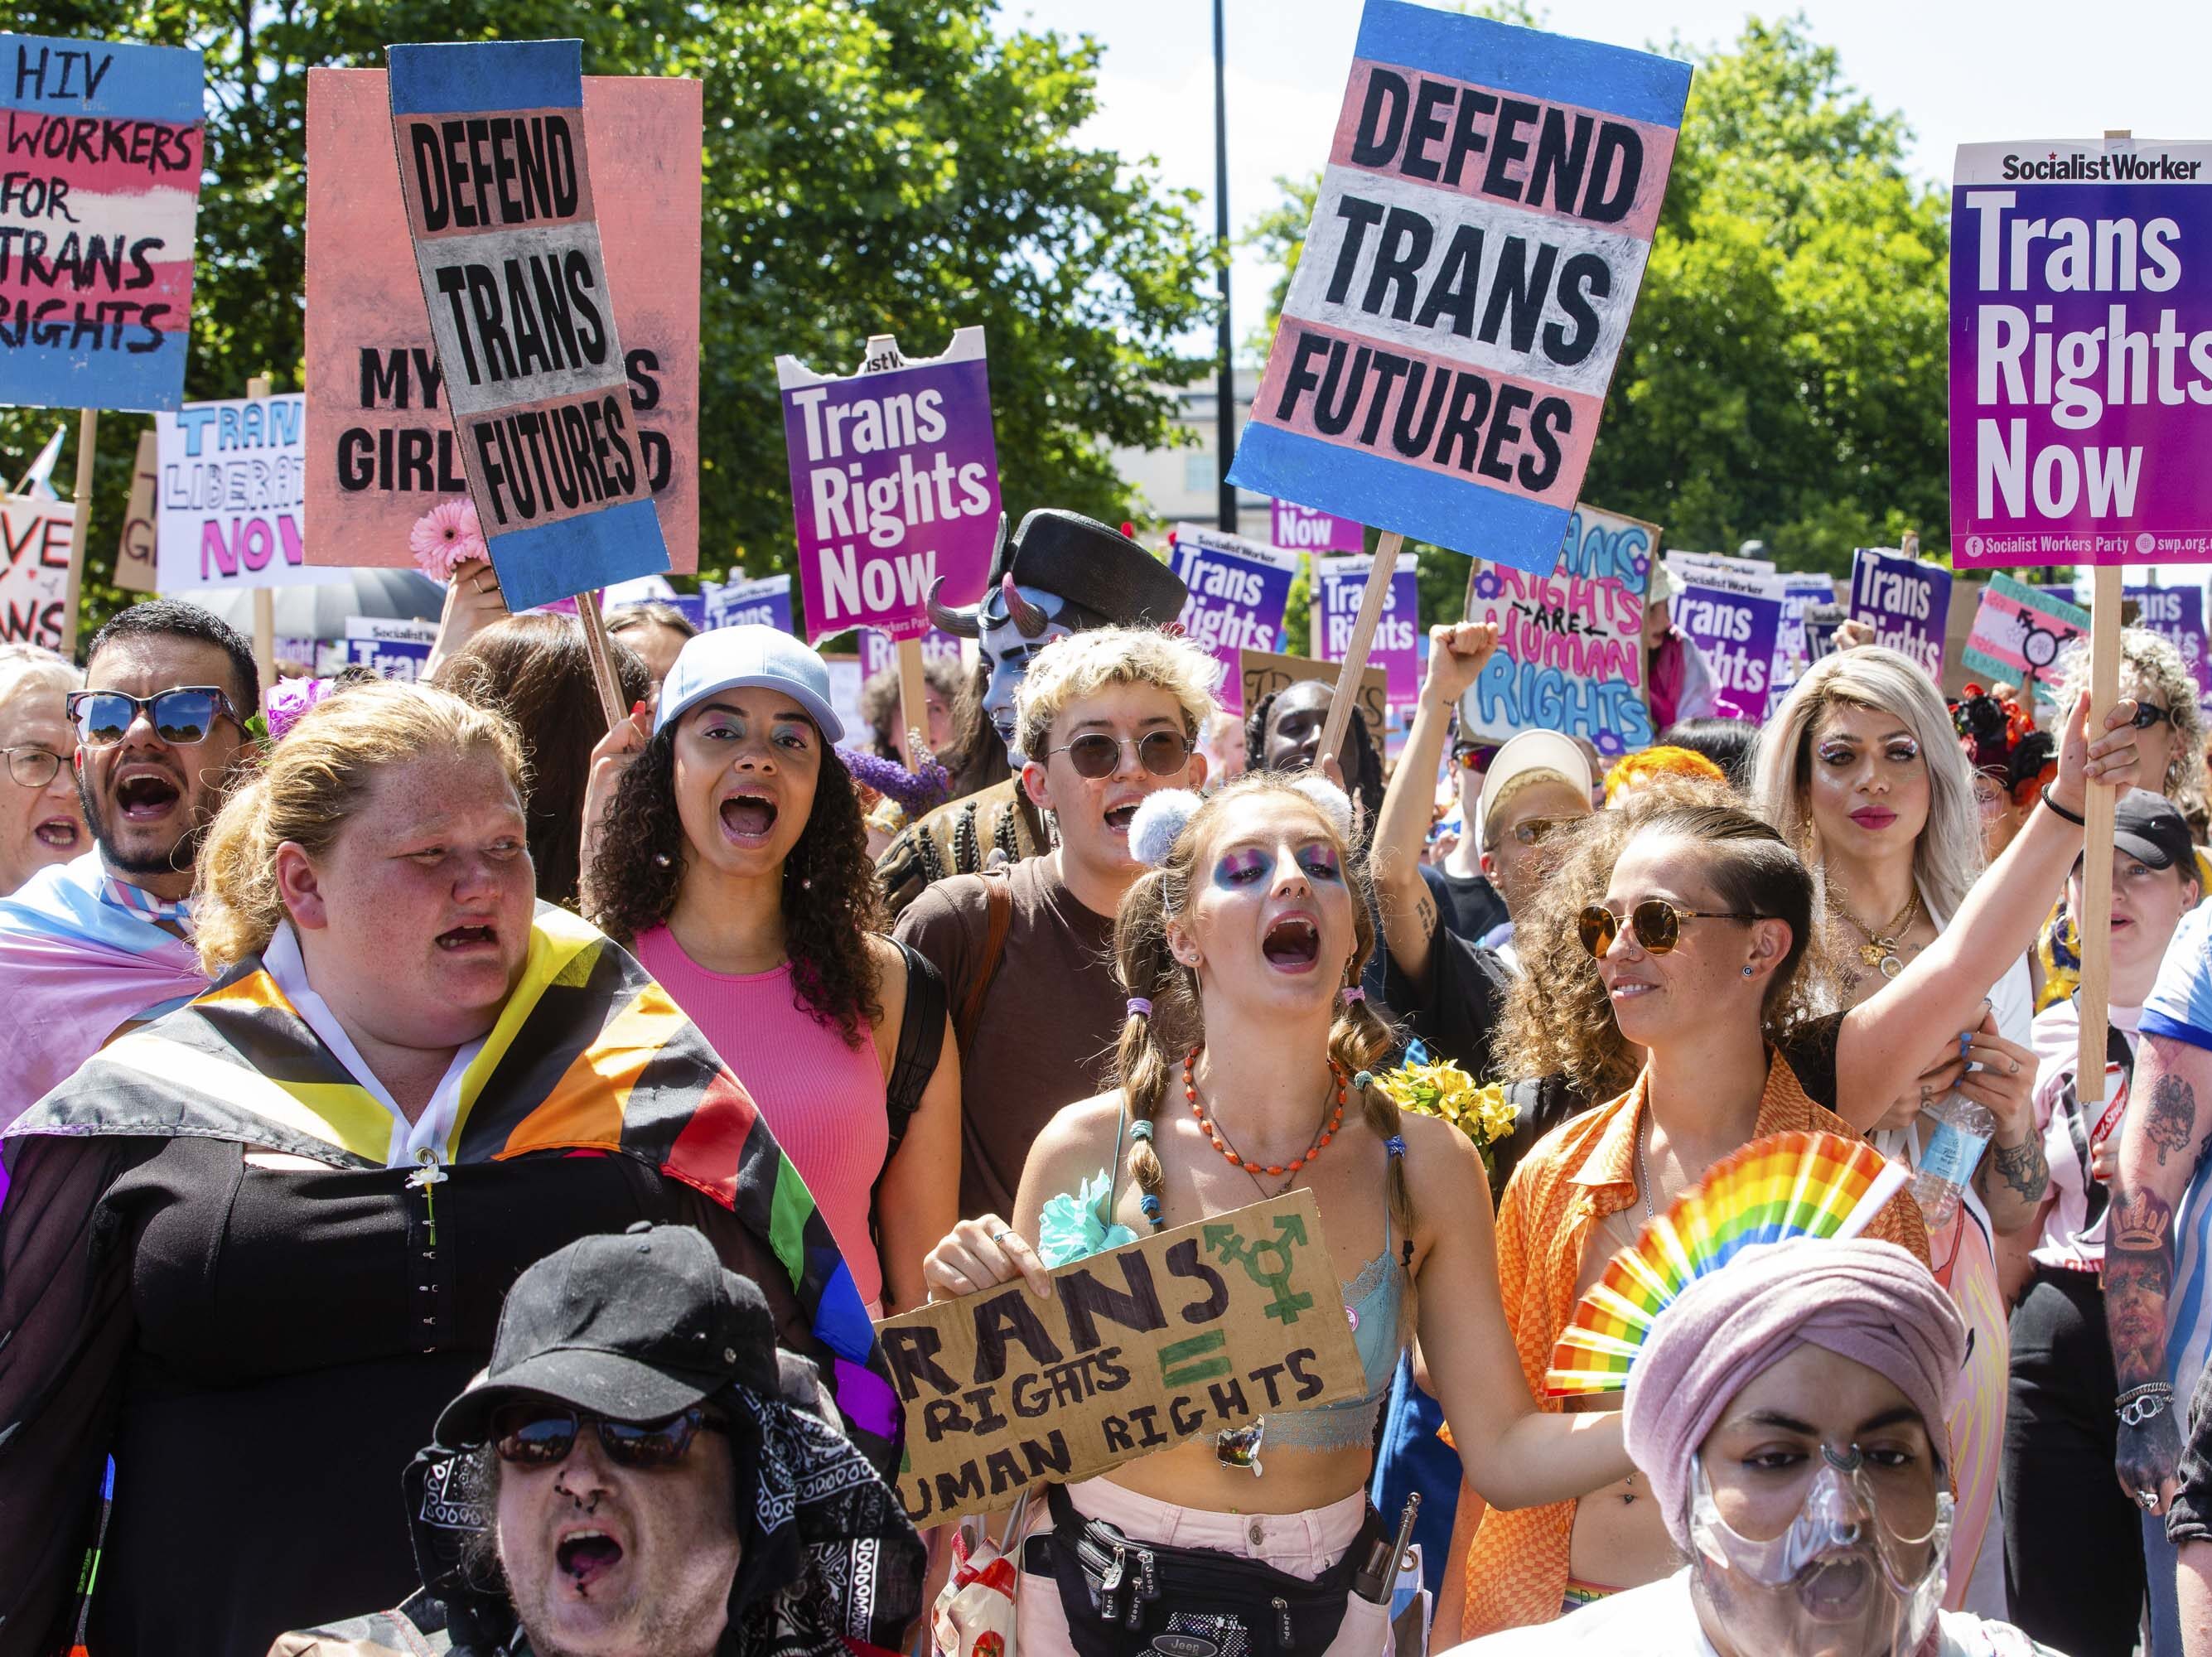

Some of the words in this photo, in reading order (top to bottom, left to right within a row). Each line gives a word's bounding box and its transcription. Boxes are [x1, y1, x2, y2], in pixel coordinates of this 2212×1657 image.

[16, 44, 113, 99] HIV
[7, 112, 195, 175] WORKERS
[410, 115, 578, 232] DEFEND
[1351, 67, 1645, 223] DEFEND
[2002, 152, 2110, 180] Socialist
[2113, 153, 2201, 180] Worker
[1, 171, 80, 222] FOR
[0, 226, 166, 292] TRANS
[1966, 191, 2181, 292] Trans
[436, 249, 606, 385] TRANS
[1326, 195, 1611, 366] TRANS
[360, 347, 441, 408] MY
[1276, 333, 1573, 493] FUTURES
[176, 401, 302, 457] TRAN
[474, 395, 637, 525] FUTURES
[792, 387, 947, 461] Trans
[166, 456, 304, 511] LIBERAT
[810, 452, 991, 548] Rights
[1978, 418, 2144, 519] Now
[201, 514, 302, 582] NO
[1279, 510, 1333, 546] Now
[1562, 512, 1648, 597] ANS
[1986, 536, 2036, 553] Socialist
[2041, 535, 2092, 552] Workers
[2096, 535, 2129, 553] Party
[2158, 537, 2212, 554] swp.org.
[819, 544, 937, 620] Now
[1178, 543, 1264, 606] Trans
[1324, 577, 1397, 613] Tras
[1860, 552, 1932, 621] Trans
[1485, 609, 1639, 688] HUMAN
[1533, 603, 1581, 636] ARE
[1478, 650, 1654, 746] RIGHTS
[881, 1238, 1229, 1402] RANS
[924, 1346, 1131, 1442] RIGHTS
[895, 1429, 1072, 1522] UMAN
[1102, 1348, 1324, 1453] RIGHTS
[1171, 1638, 1200, 1654] Jeep
